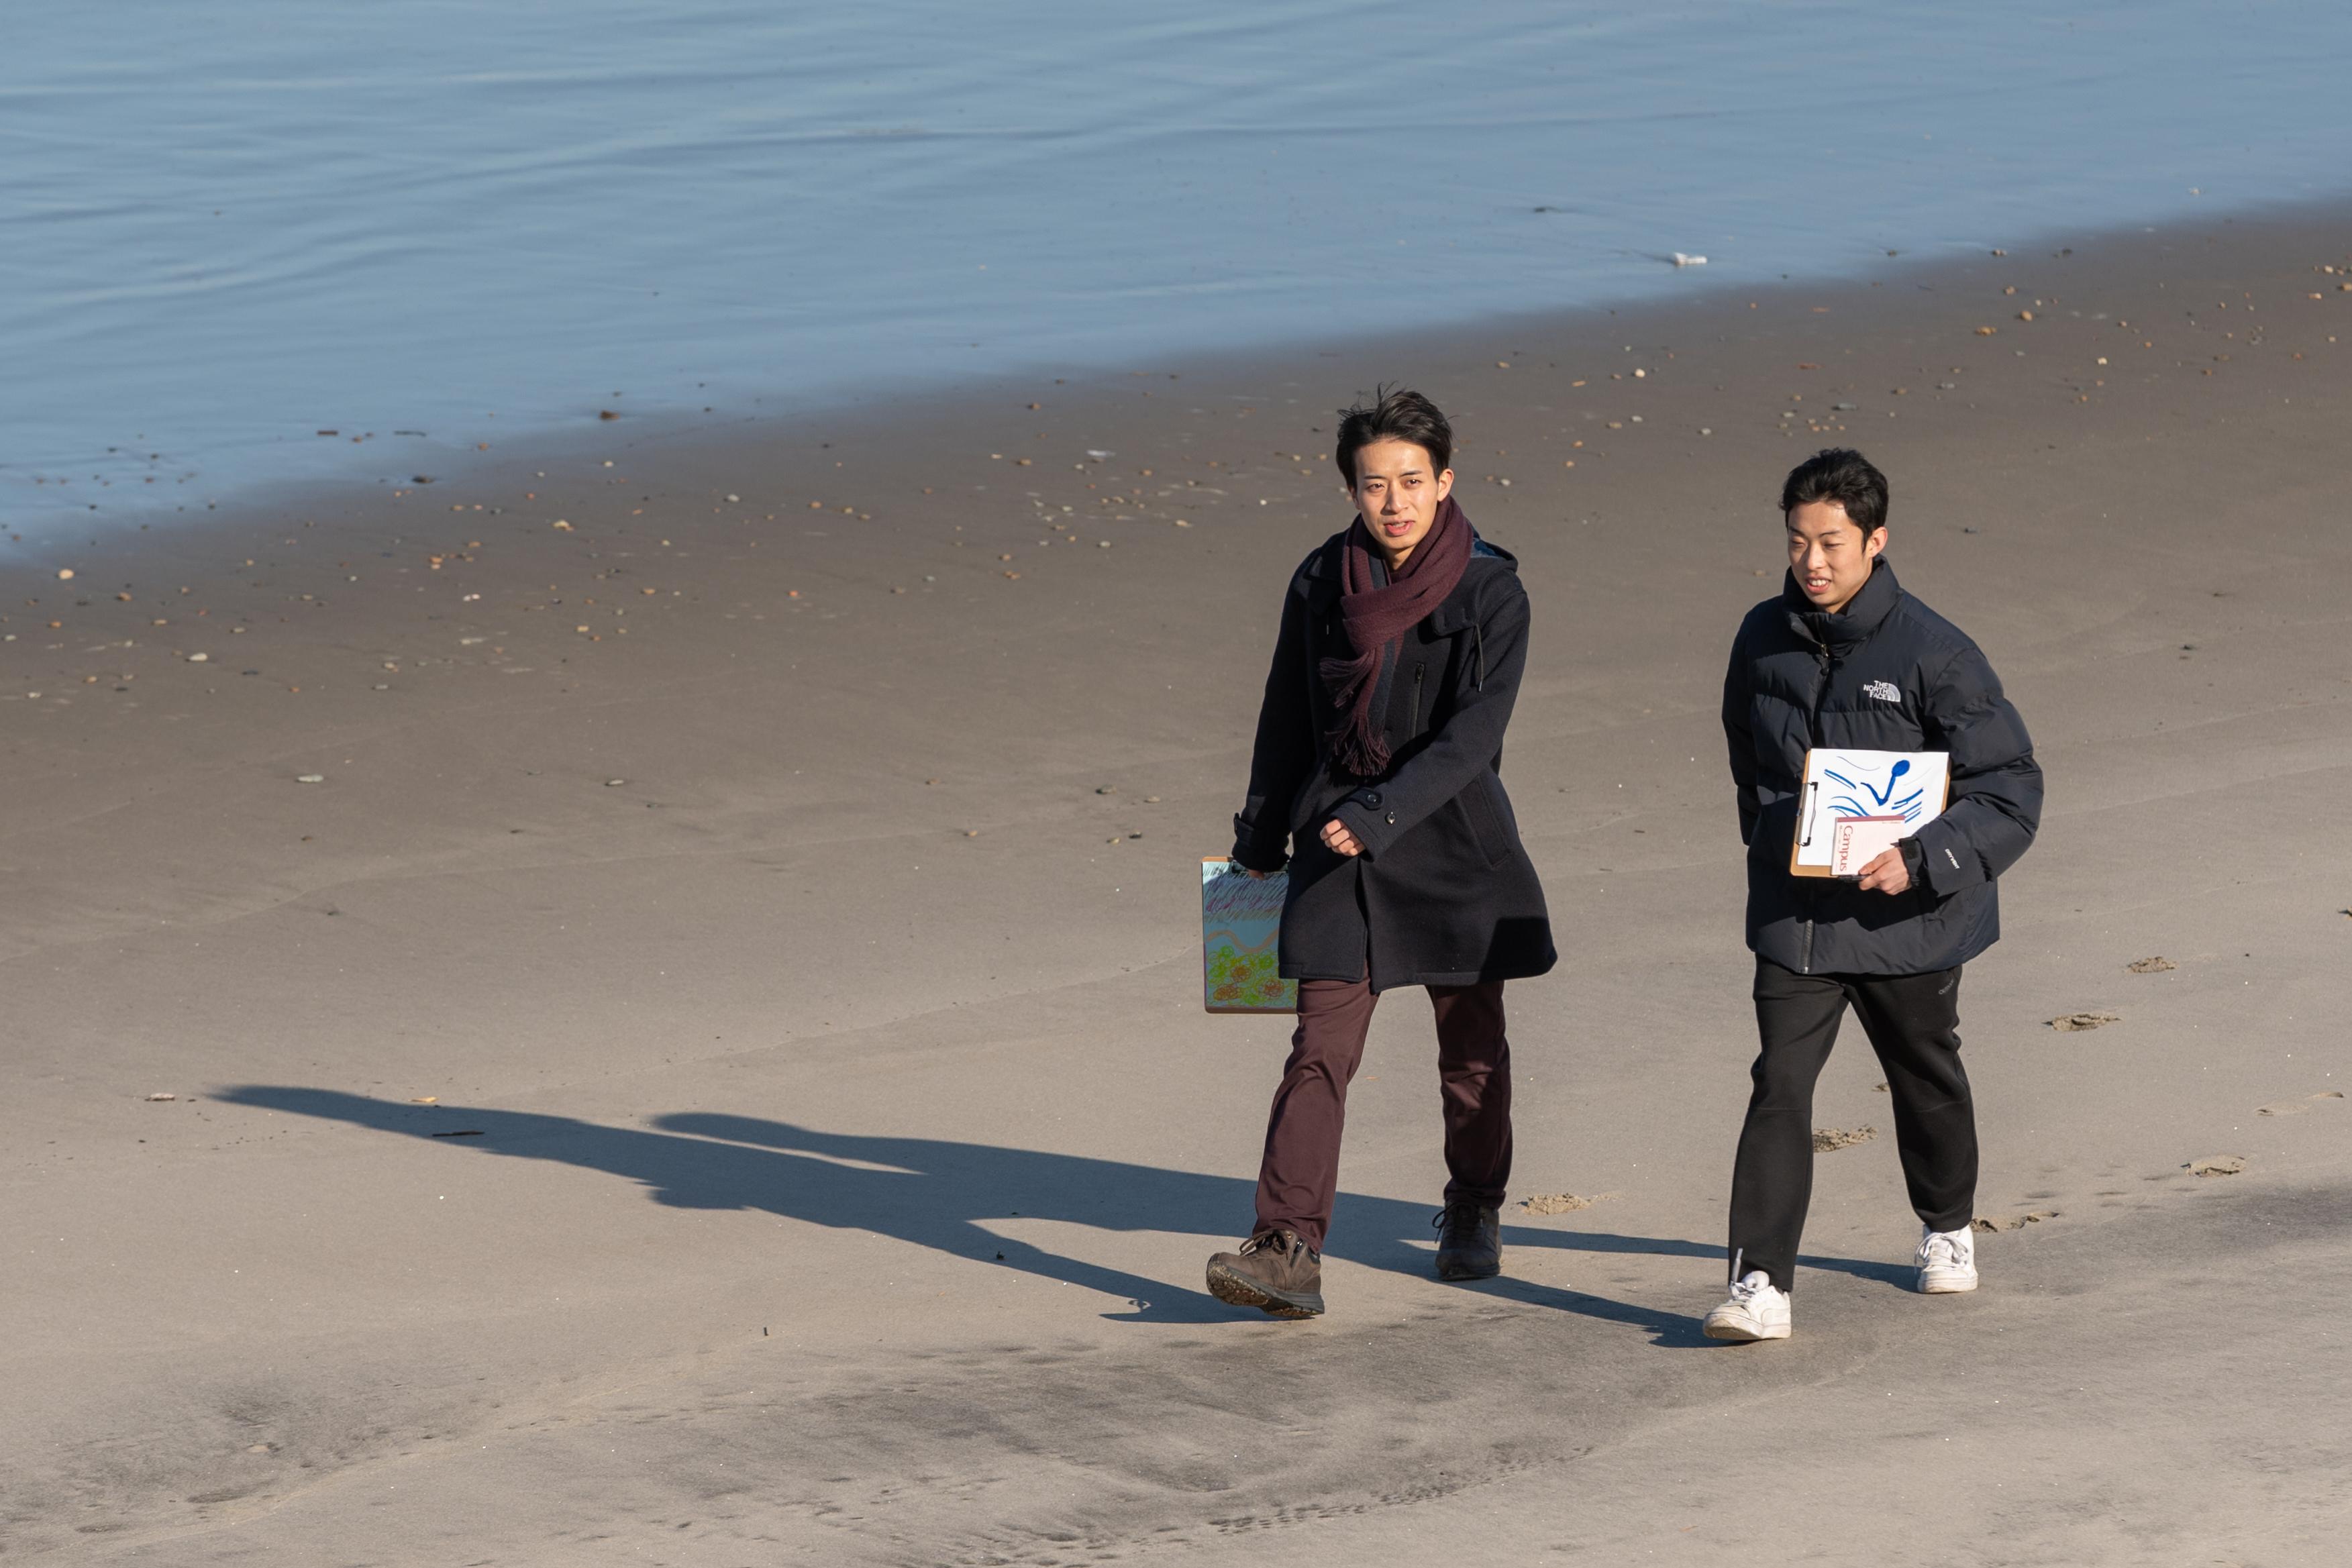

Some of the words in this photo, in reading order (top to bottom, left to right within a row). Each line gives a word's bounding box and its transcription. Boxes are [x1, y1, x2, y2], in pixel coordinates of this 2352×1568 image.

[1874, 680, 1888, 688] THE
[1863, 684, 1888, 694] NORTH
[1870, 691, 1887, 700] FACE
[1839, 825, 1853, 872] Campus
